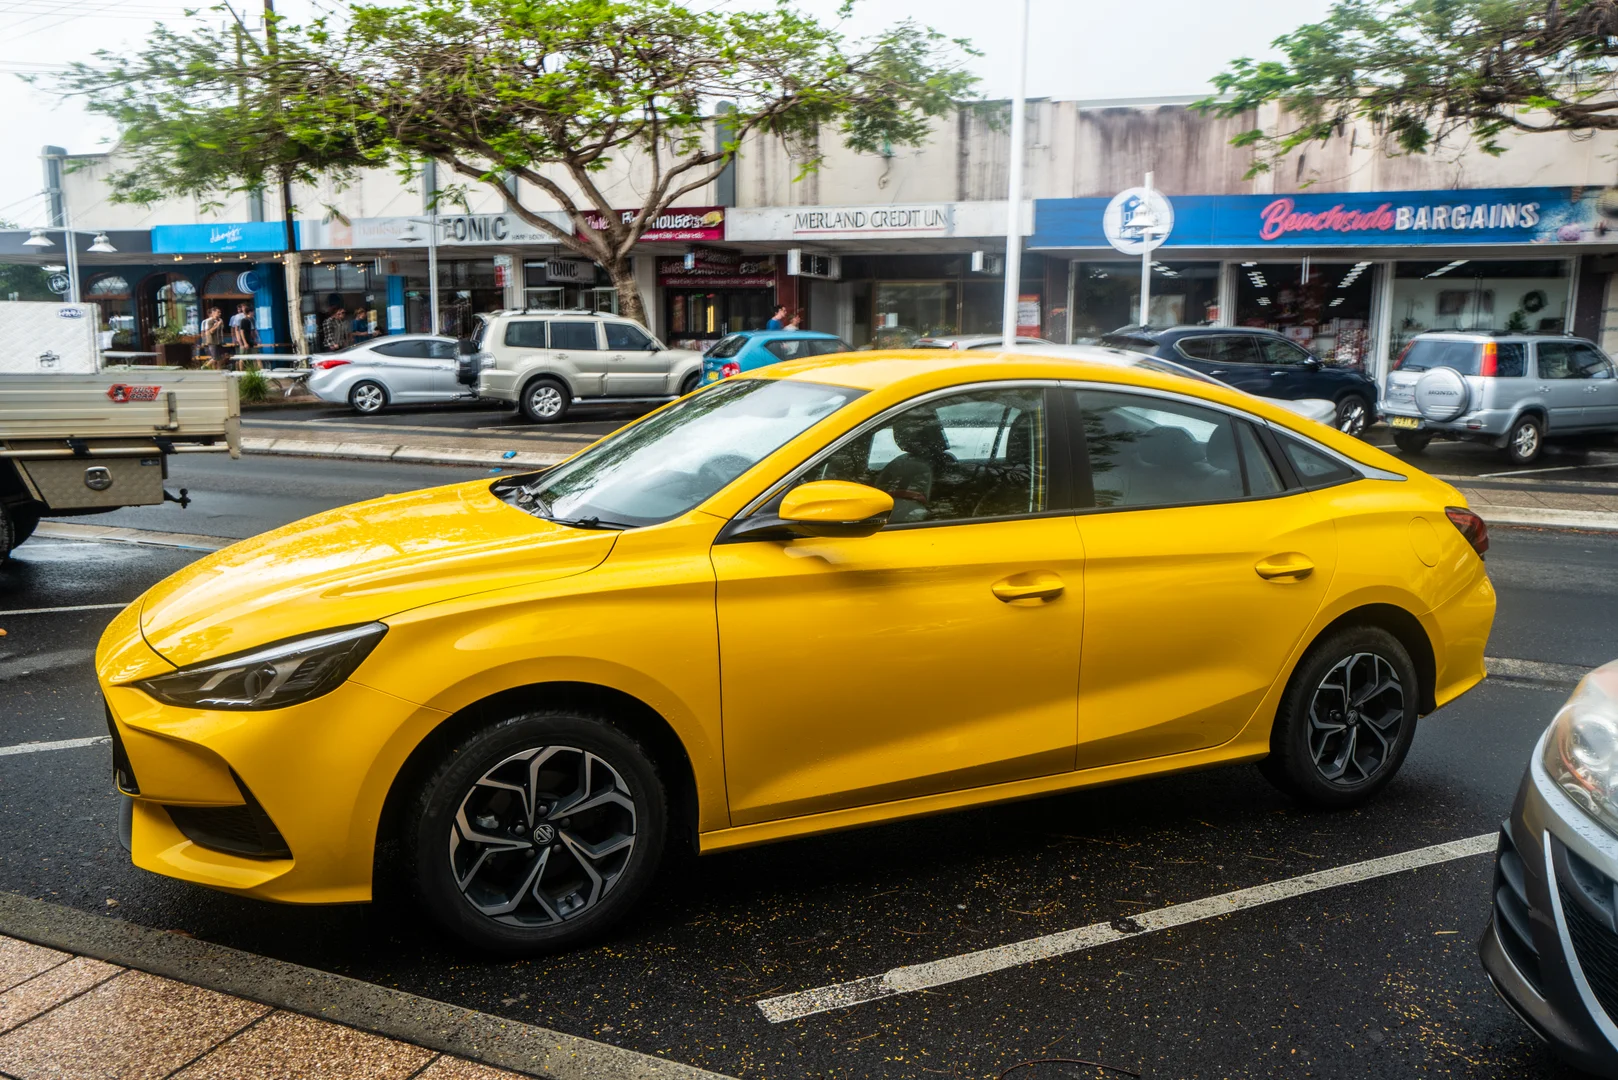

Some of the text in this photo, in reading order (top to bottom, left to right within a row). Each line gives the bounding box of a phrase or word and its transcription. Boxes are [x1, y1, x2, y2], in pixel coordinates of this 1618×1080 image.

[871, 210, 920, 227] CREDIT
[1260, 198, 1540, 240] Beachside BARGAINS
